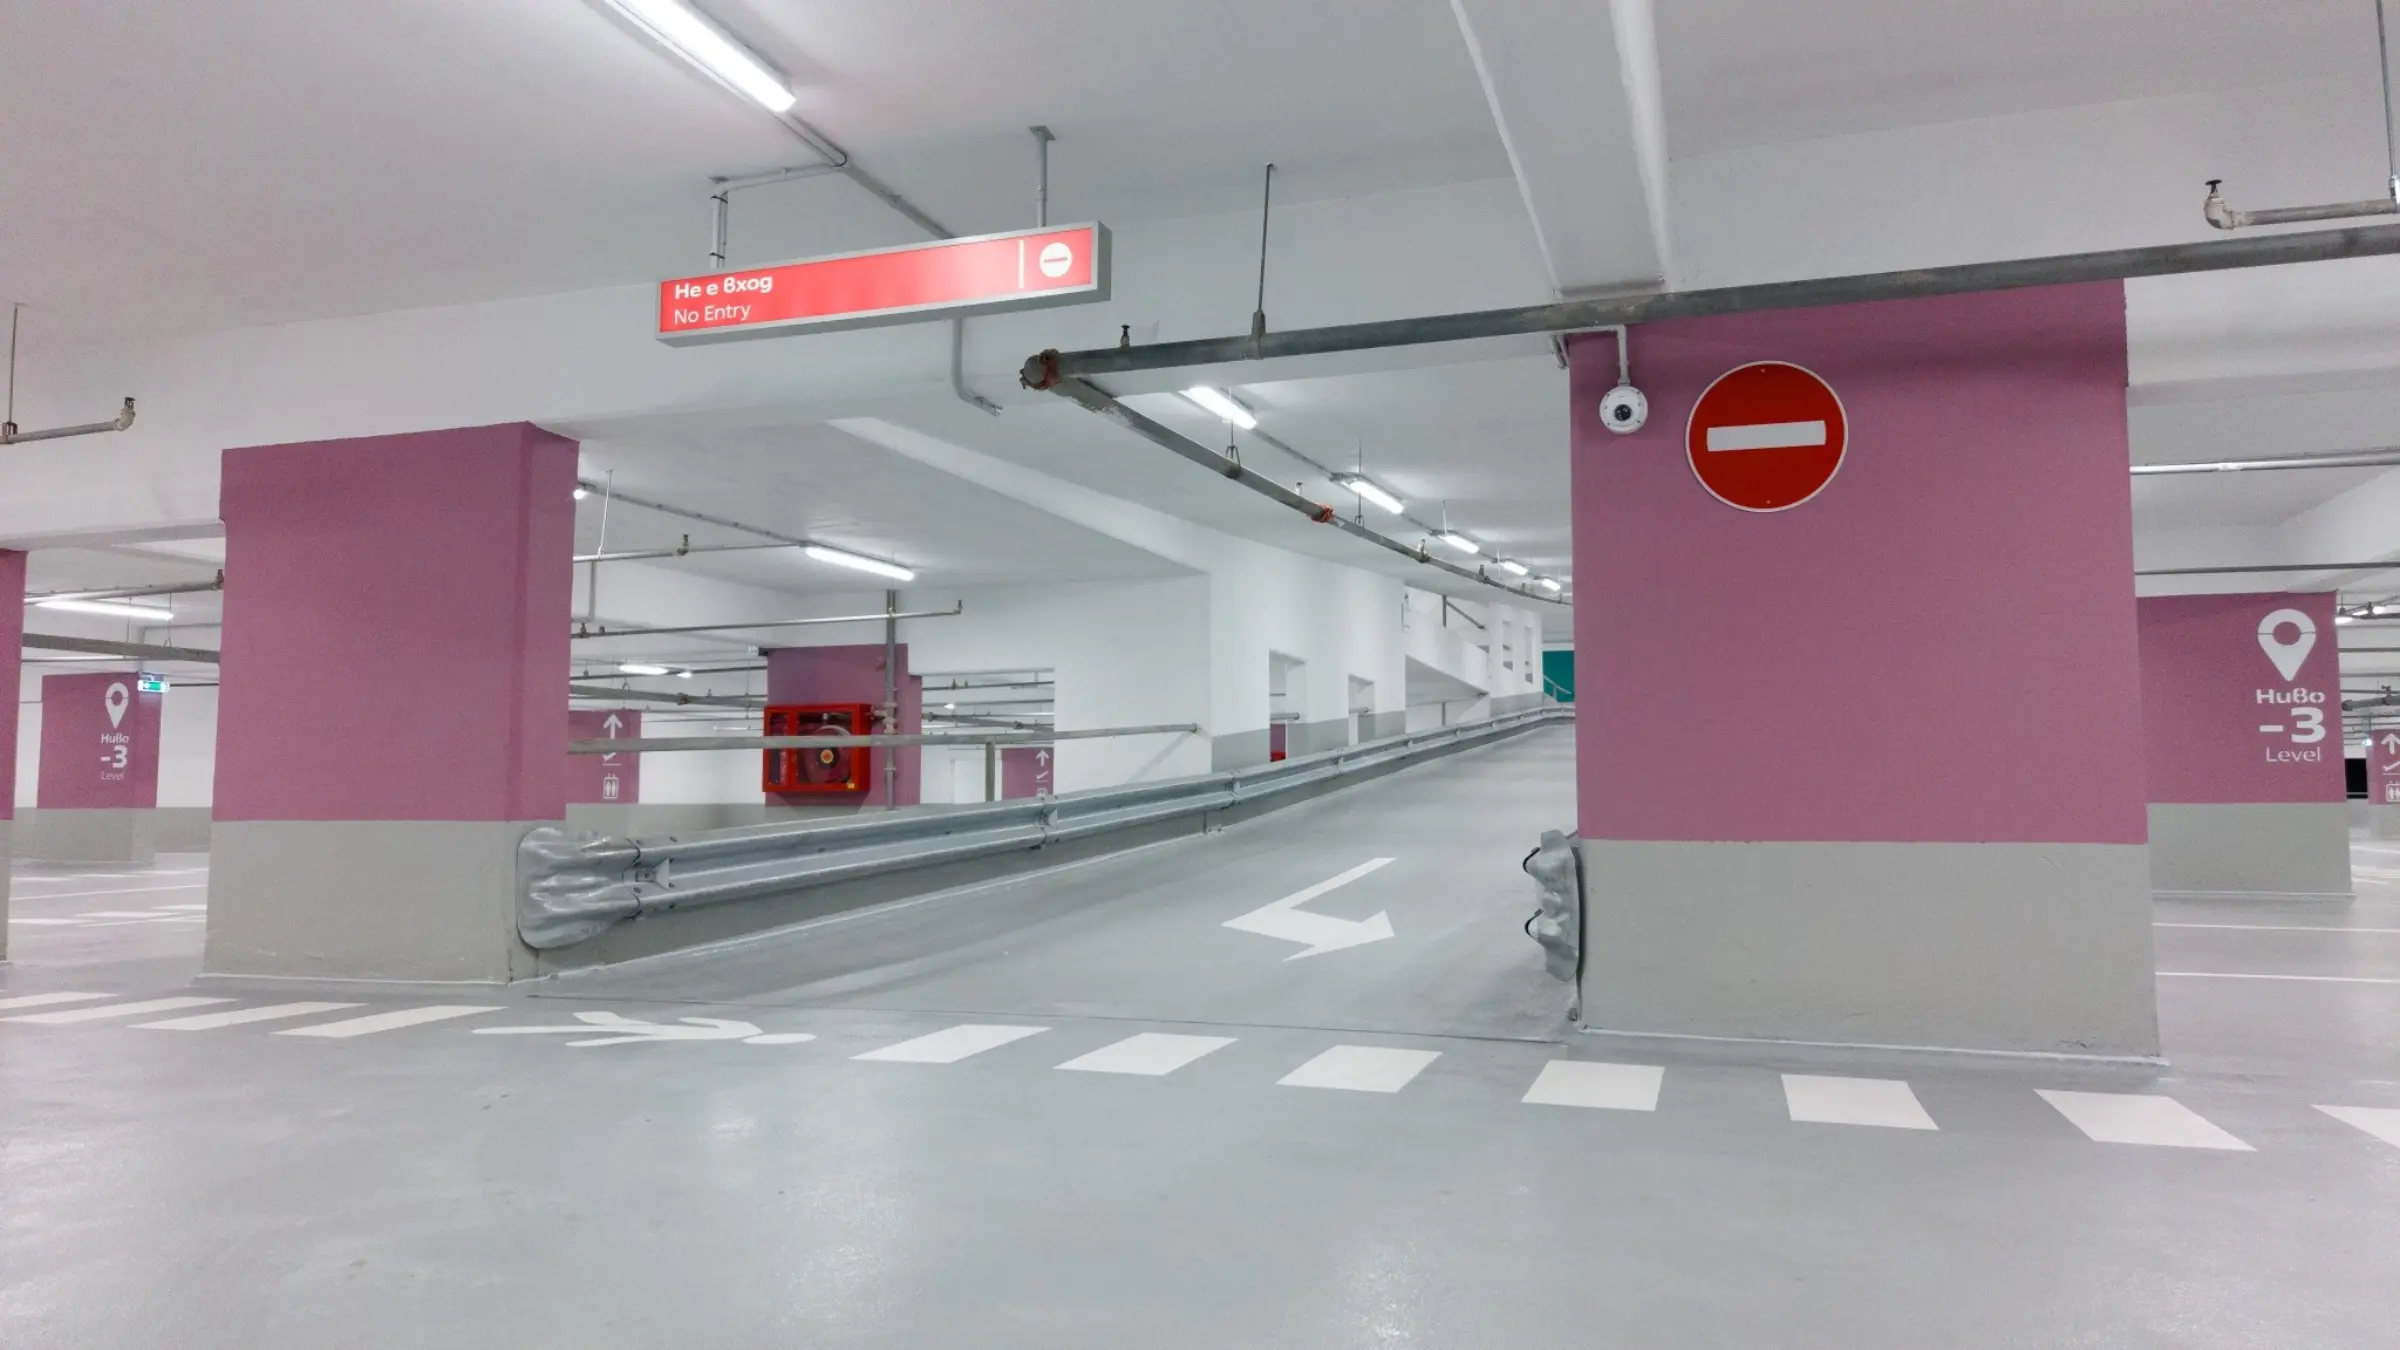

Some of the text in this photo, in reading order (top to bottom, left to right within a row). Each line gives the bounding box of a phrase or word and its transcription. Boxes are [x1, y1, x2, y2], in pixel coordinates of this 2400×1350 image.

[675, 283, 702, 299] Не
[706, 283, 718, 296] е
[674, 303, 751, 325] No Entry
[2256, 687, 2326, 704] Ниво
[2259, 706, 2326, 743] -3
[100, 745, 128, 768] -3
[2266, 746, 2321, 762] Level
[101, 770, 125, 780] Level
